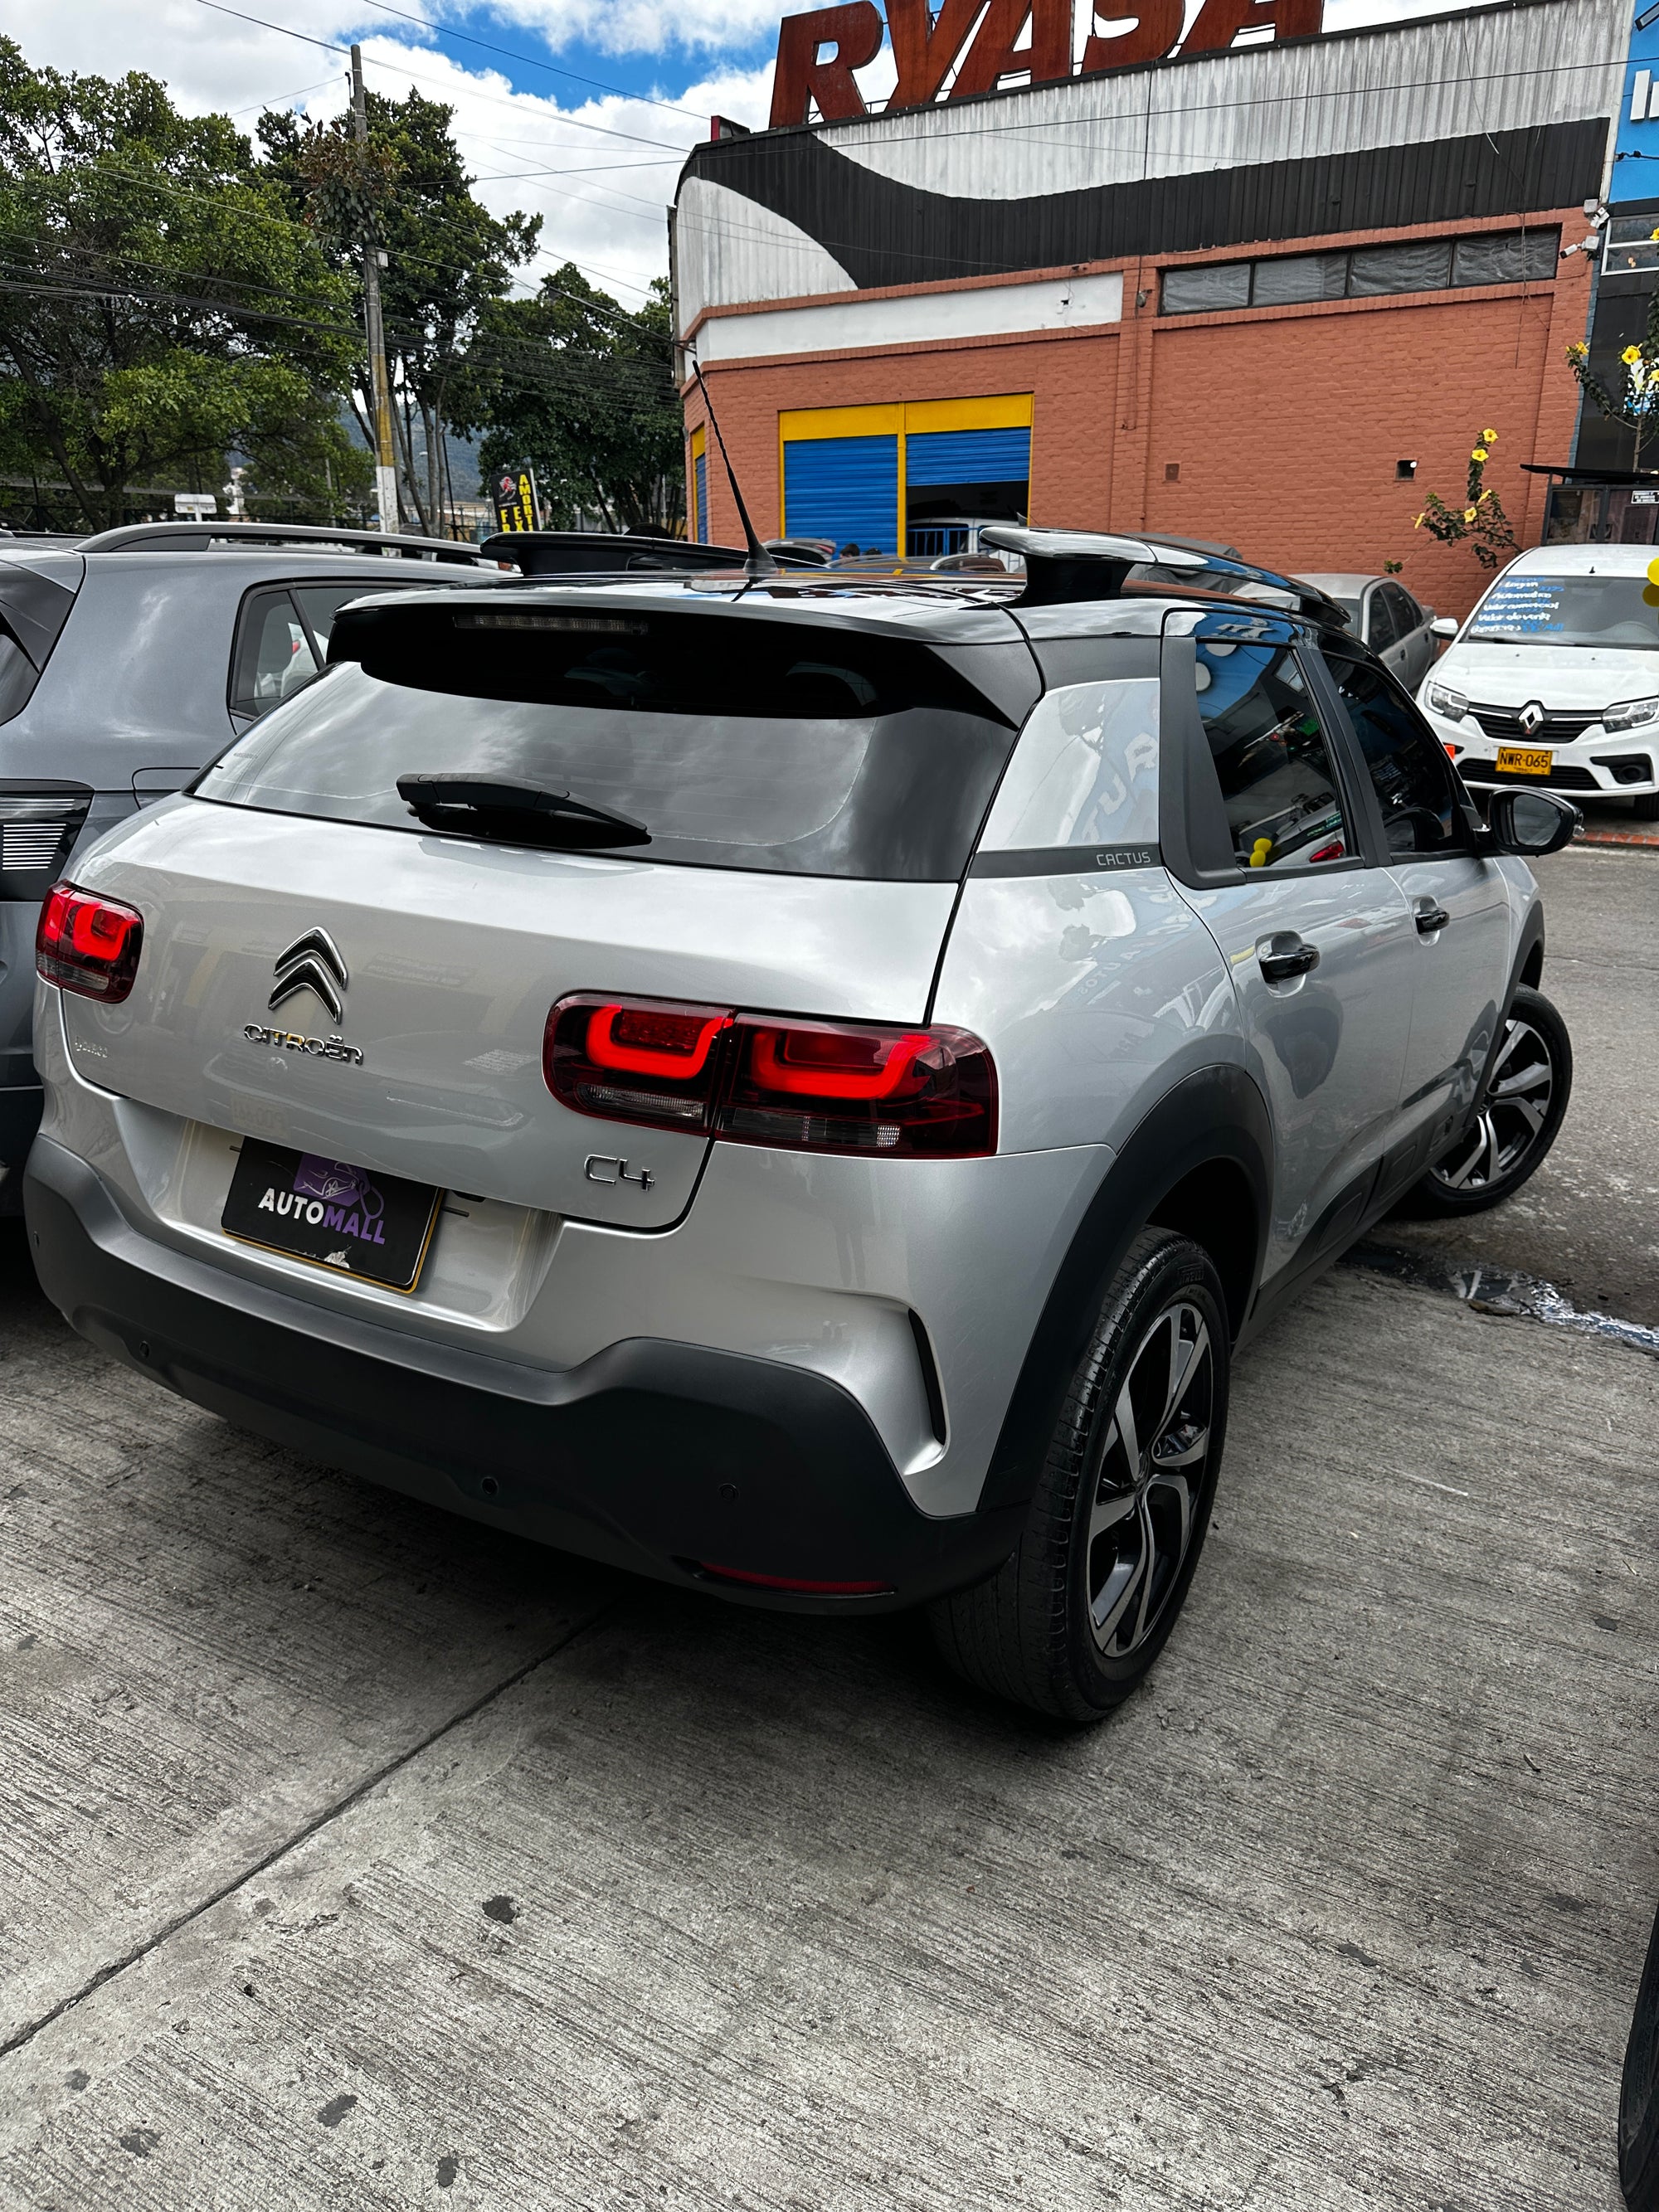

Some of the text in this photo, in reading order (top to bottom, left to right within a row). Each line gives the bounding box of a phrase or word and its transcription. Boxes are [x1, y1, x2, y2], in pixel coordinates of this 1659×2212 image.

[1499, 751, 1550, 769] NWR-065
[1096, 851, 1151, 866] CACTUS
[583, 1154, 655, 1192] C4
[258, 1187, 386, 1245] AUTOMALL
